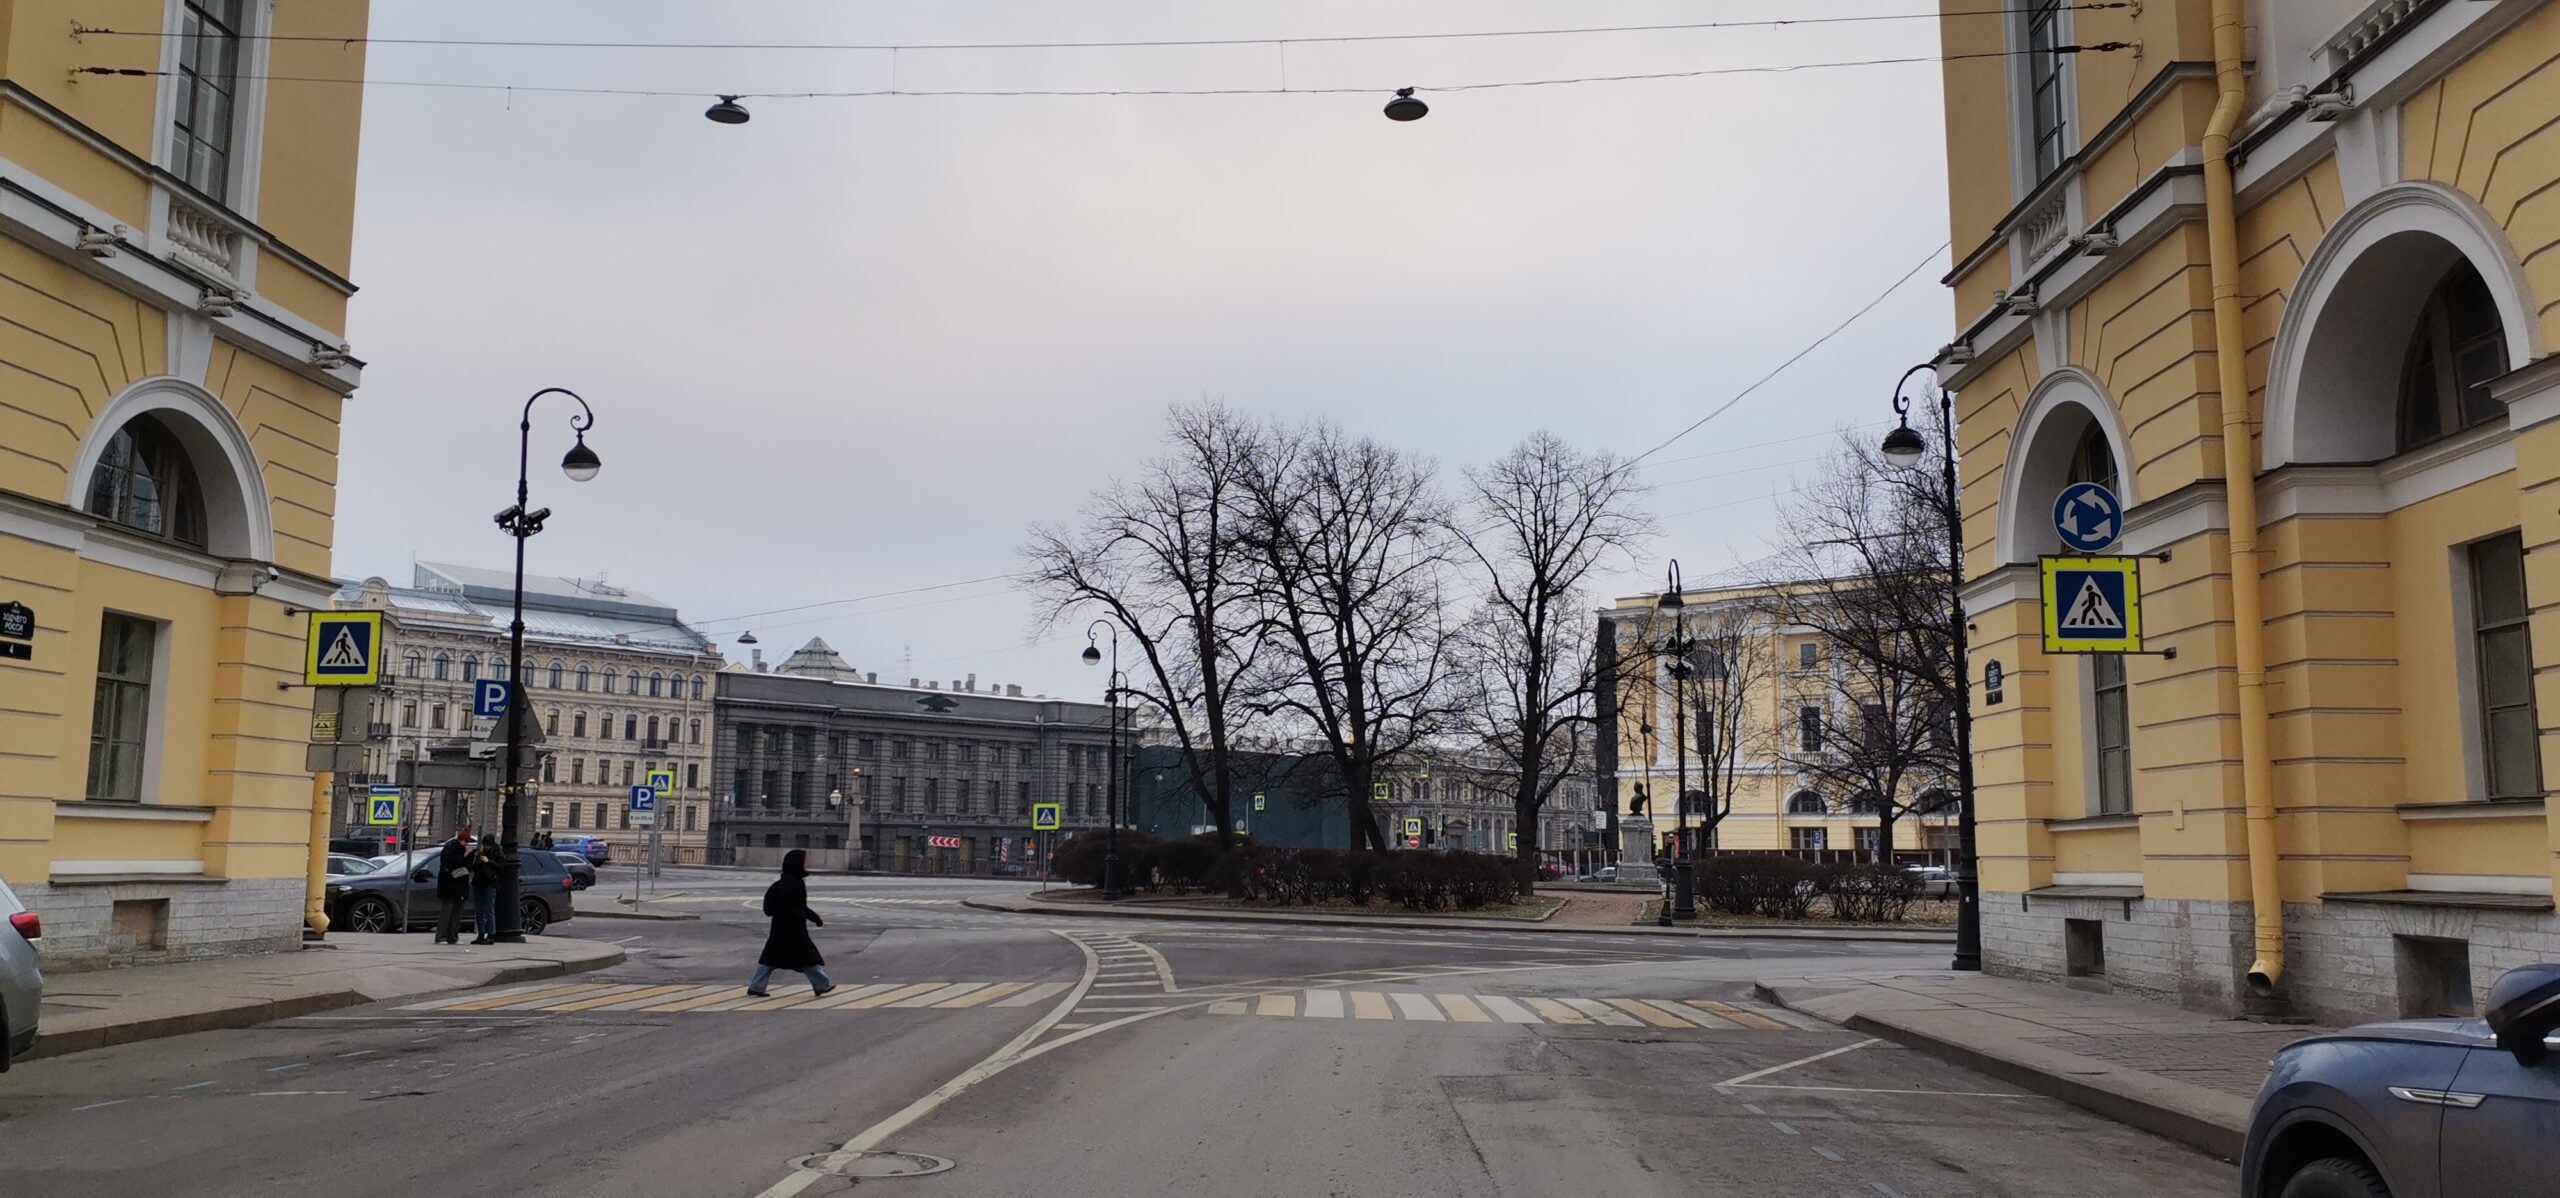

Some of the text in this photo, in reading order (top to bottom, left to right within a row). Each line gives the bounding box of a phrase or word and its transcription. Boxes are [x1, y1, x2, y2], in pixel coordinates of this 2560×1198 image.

[4, 621, 24, 632] РОССИ
[484, 683, 506, 713] P
[637, 788, 651, 808] P
